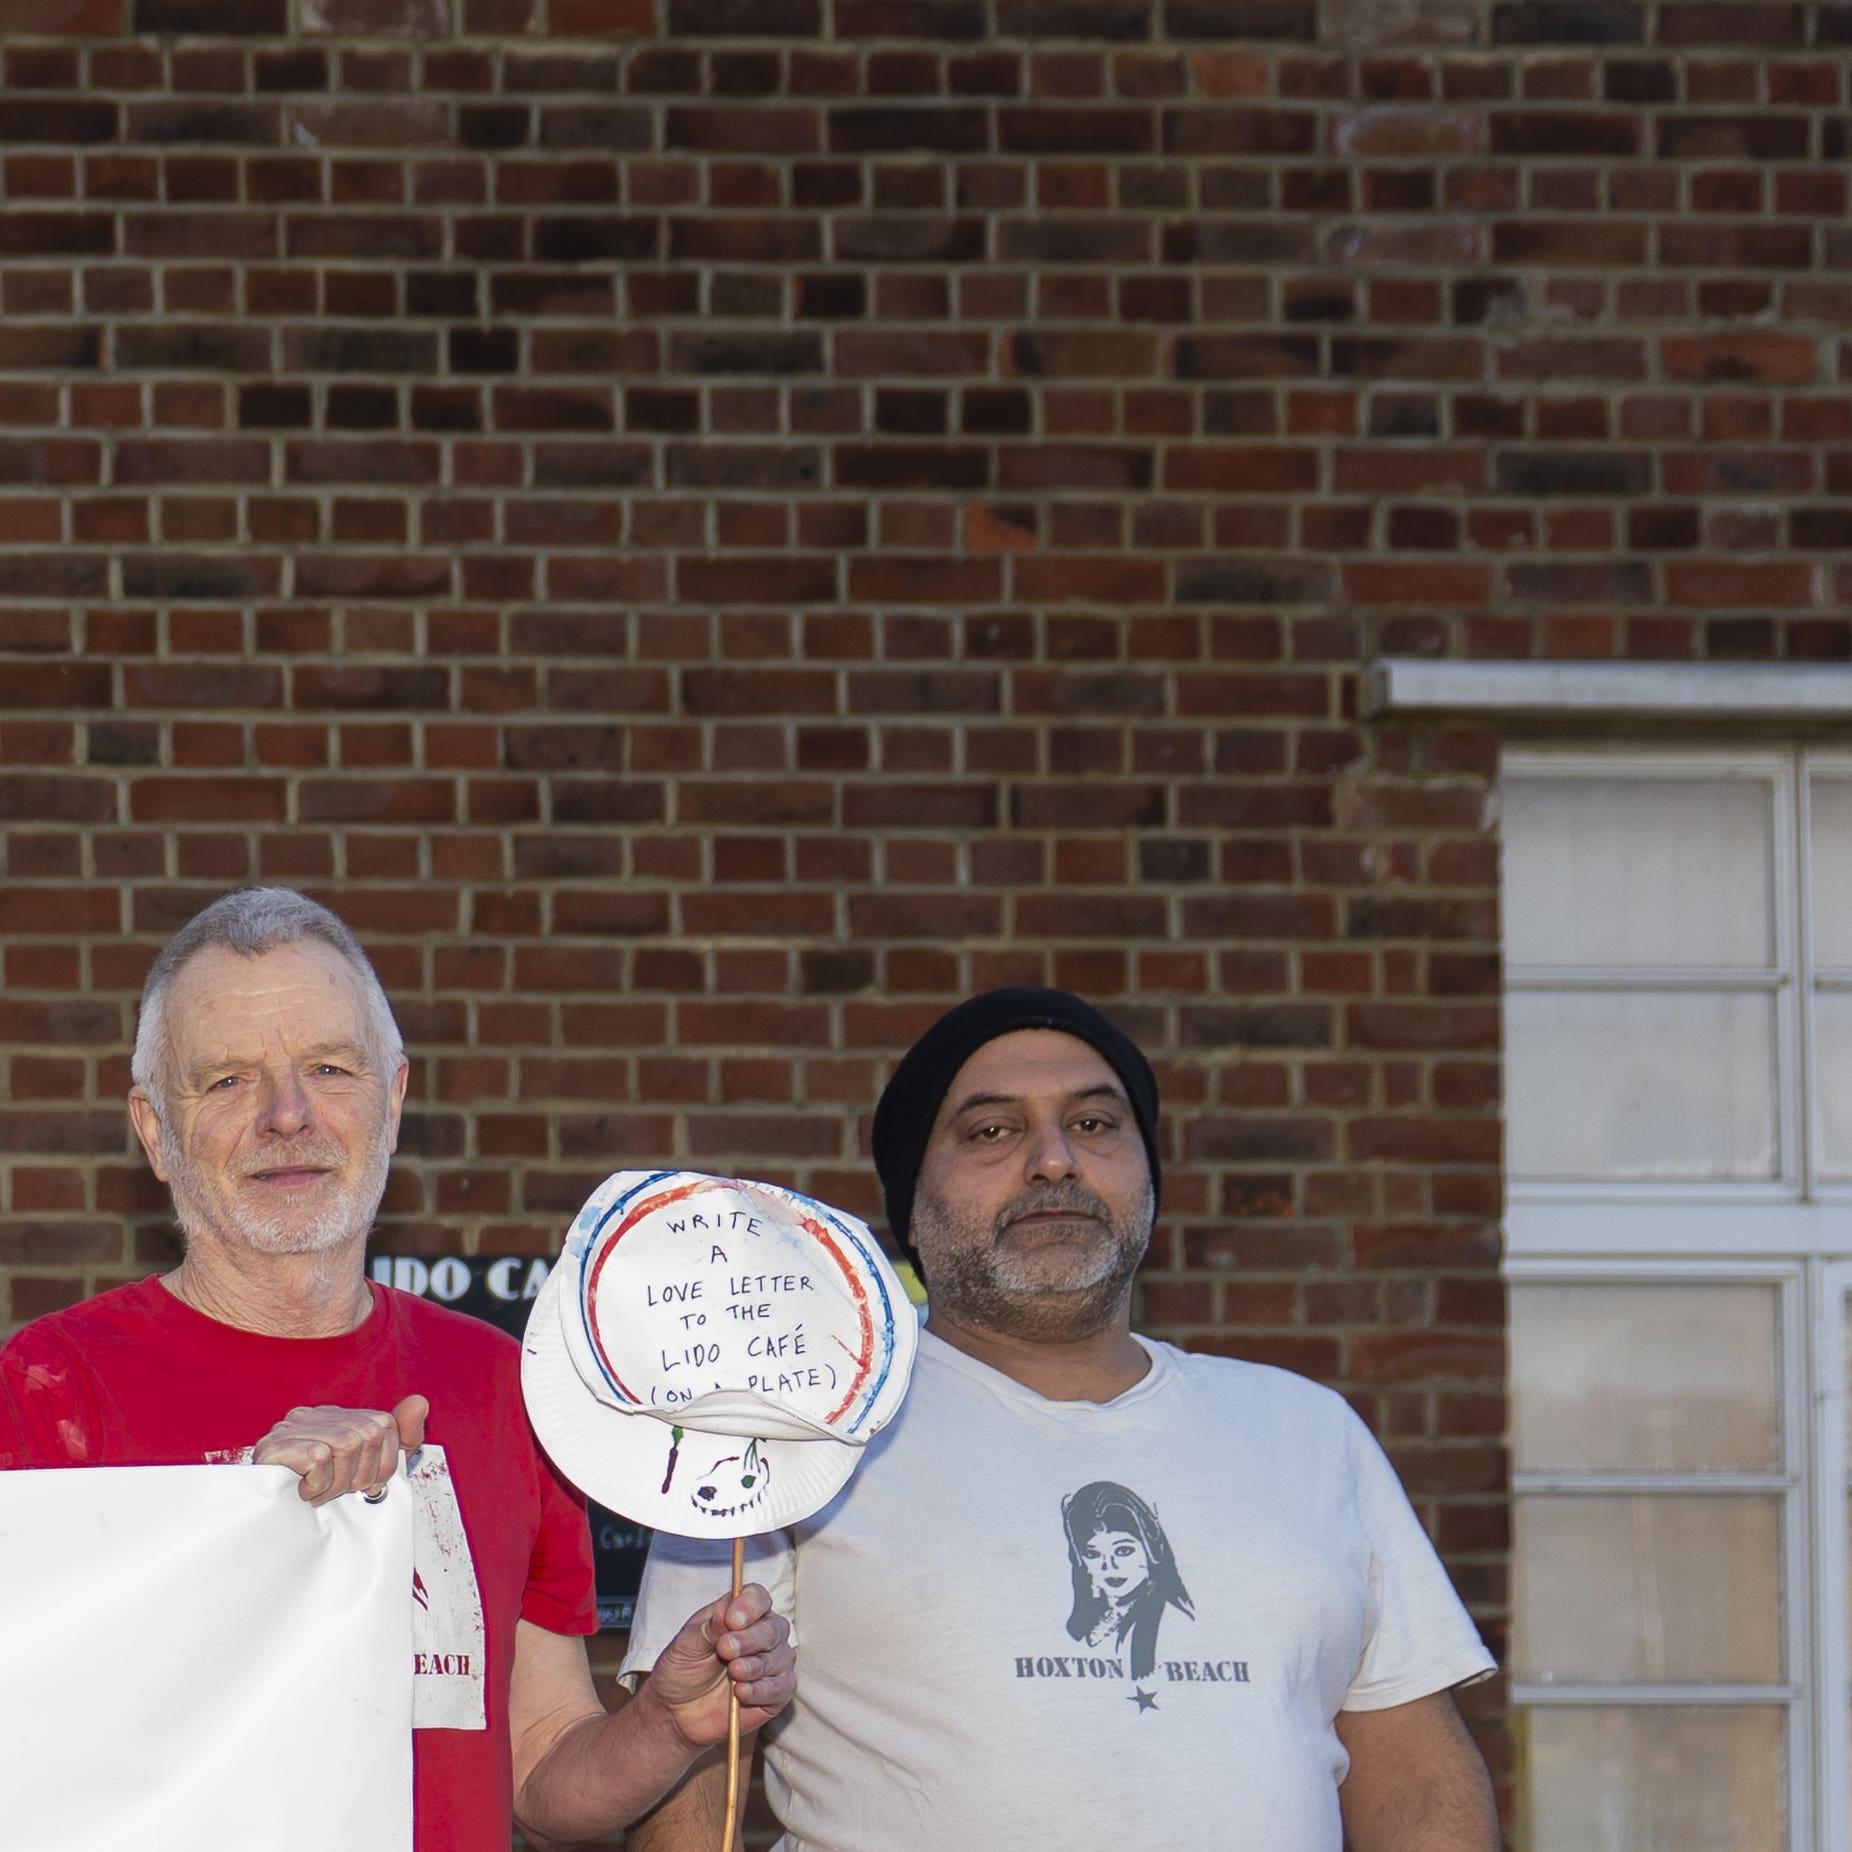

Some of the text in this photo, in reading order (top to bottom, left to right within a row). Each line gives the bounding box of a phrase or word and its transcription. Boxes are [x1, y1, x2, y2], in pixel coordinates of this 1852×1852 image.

[666, 1211, 763, 1236] WRITE
[711, 1245, 728, 1263] A
[647, 1275, 814, 1306] LOVE LETTER
[679, 1303, 771, 1330] TO THE
[662, 1323, 807, 1372] LIDO CAFÉ
[1014, 1657, 1250, 1683] HOXTON BEACH
